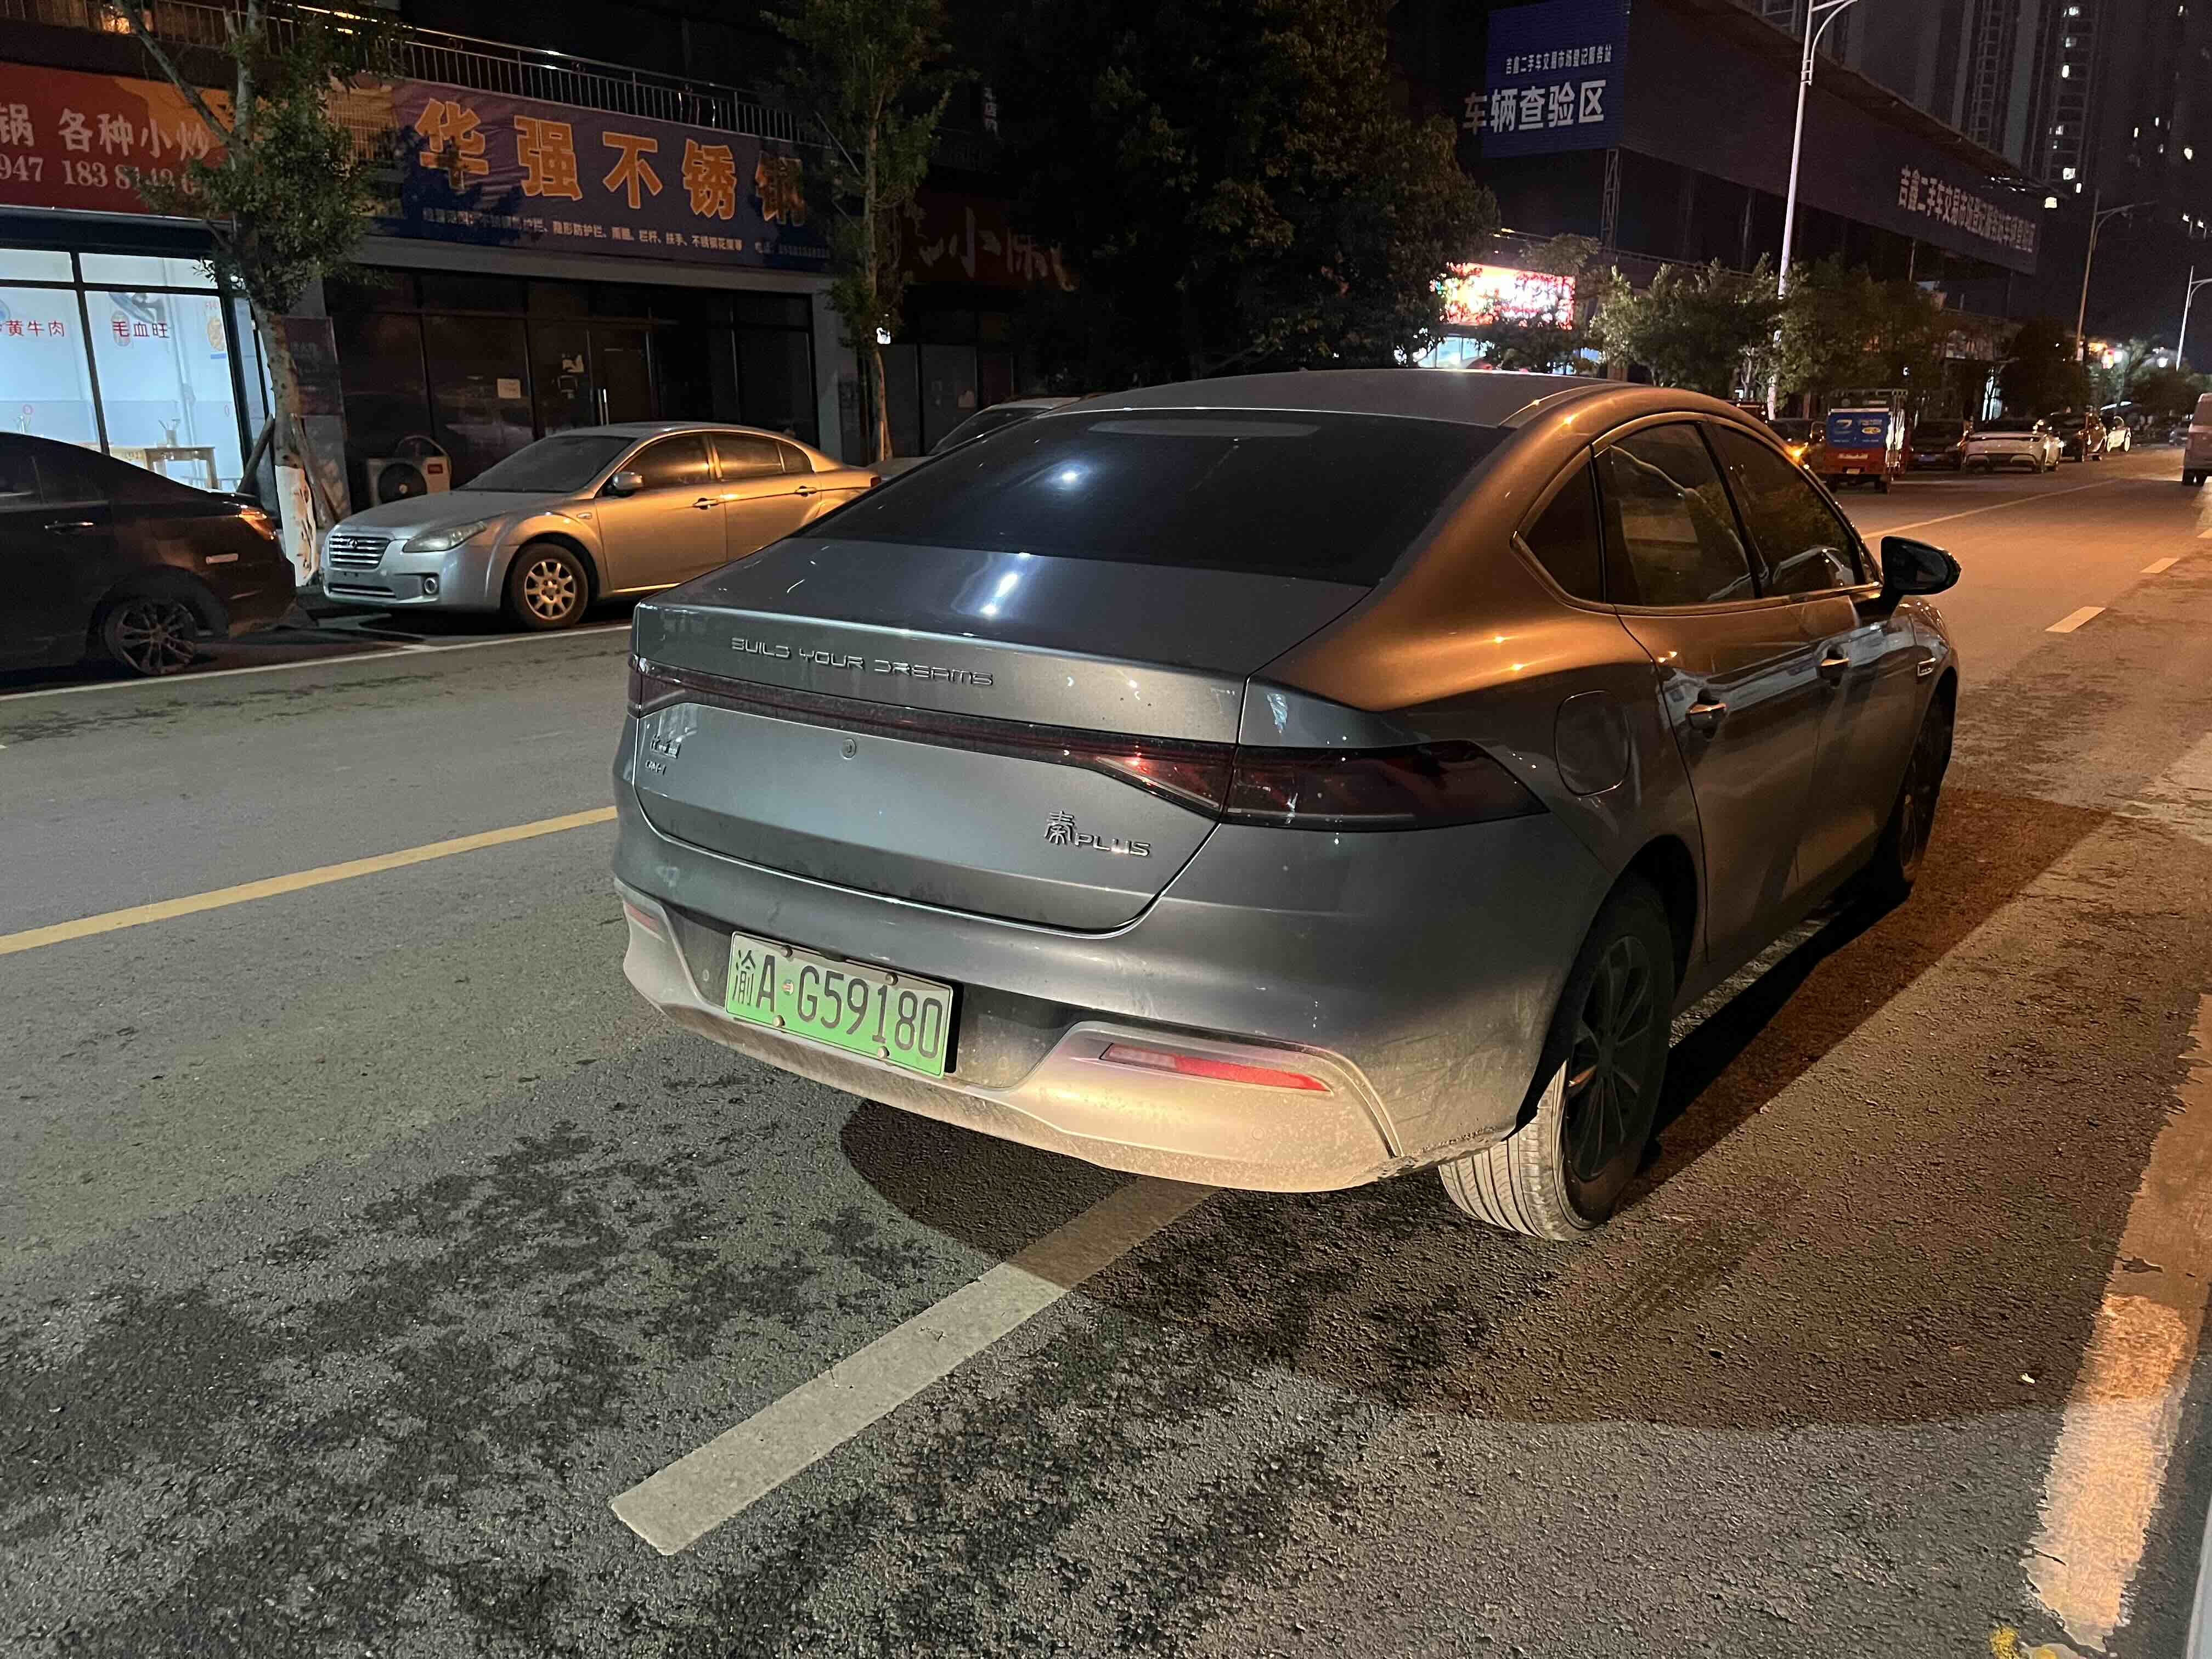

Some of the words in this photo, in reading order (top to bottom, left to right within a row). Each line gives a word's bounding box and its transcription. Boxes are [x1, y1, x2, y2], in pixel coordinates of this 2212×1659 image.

[1462, 79, 1606, 135] 车辆查验区
[58, 108, 211, 161] 各种小炒
[414, 98, 806, 225] 华强不锈钢
[0, 320, 65, 337] 黄牛肉
[112, 320, 168, 338] 毛血旺
[730, 636, 791, 659] BUILD
[799, 649, 865, 672] YOUR
[873, 658, 994, 686] DREAMS
